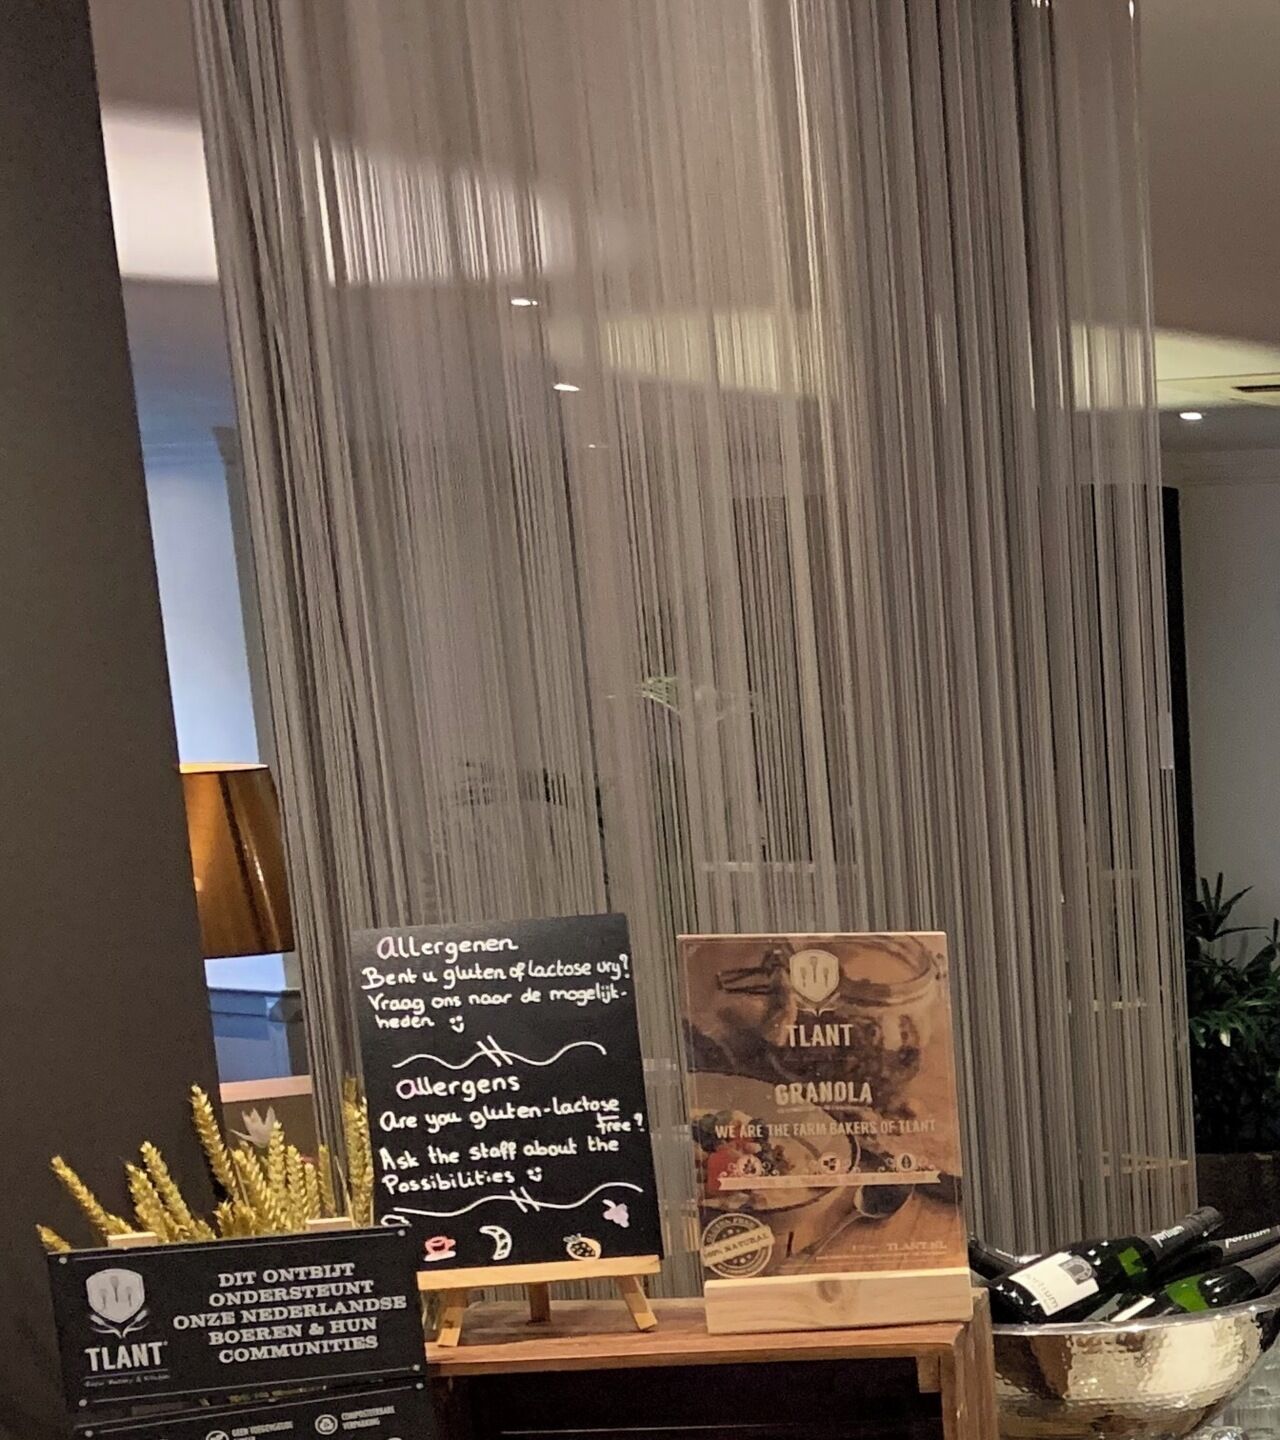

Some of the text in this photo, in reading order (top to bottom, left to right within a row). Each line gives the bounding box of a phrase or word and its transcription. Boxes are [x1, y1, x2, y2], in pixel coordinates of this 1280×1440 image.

[376, 936, 518, 963] Allergenen
[361, 967, 417, 990] Bent
[422, 971, 437, 982] u
[444, 963, 507, 989] gluten
[509, 962, 525, 981] of
[528, 960, 591, 977] lactose
[368, 993, 425, 1015] Vraag
[432, 994, 461, 1008] ons
[469, 993, 512, 1005] naar
[521, 987, 541, 1003] de
[375, 1015, 434, 1029] heden
[785, 1024, 853, 1047] TLANT
[396, 1075, 520, 1102] Allergens
[775, 1082, 873, 1105] GRANOLA
[380, 1112, 417, 1131] Are
[426, 1114, 462, 1133] you
[715, 1120, 935, 1138] WE ARE THE FARM BAKERS OF TLANT
[379, 1136, 619, 1171] Ask the staff about the
[382, 1170, 515, 1194] Possibilities
[218, 1262, 355, 1288] DIT ONTBIJT
[209, 1280, 374, 1307] ONDERSTEUNT
[173, 1296, 406, 1330] ONZE NEDERLANDSE
[209, 1317, 377, 1346] BOEREN & HUN
[84, 1342, 164, 1372] TLANT
[218, 1335, 378, 1364] COMMUNITIES
